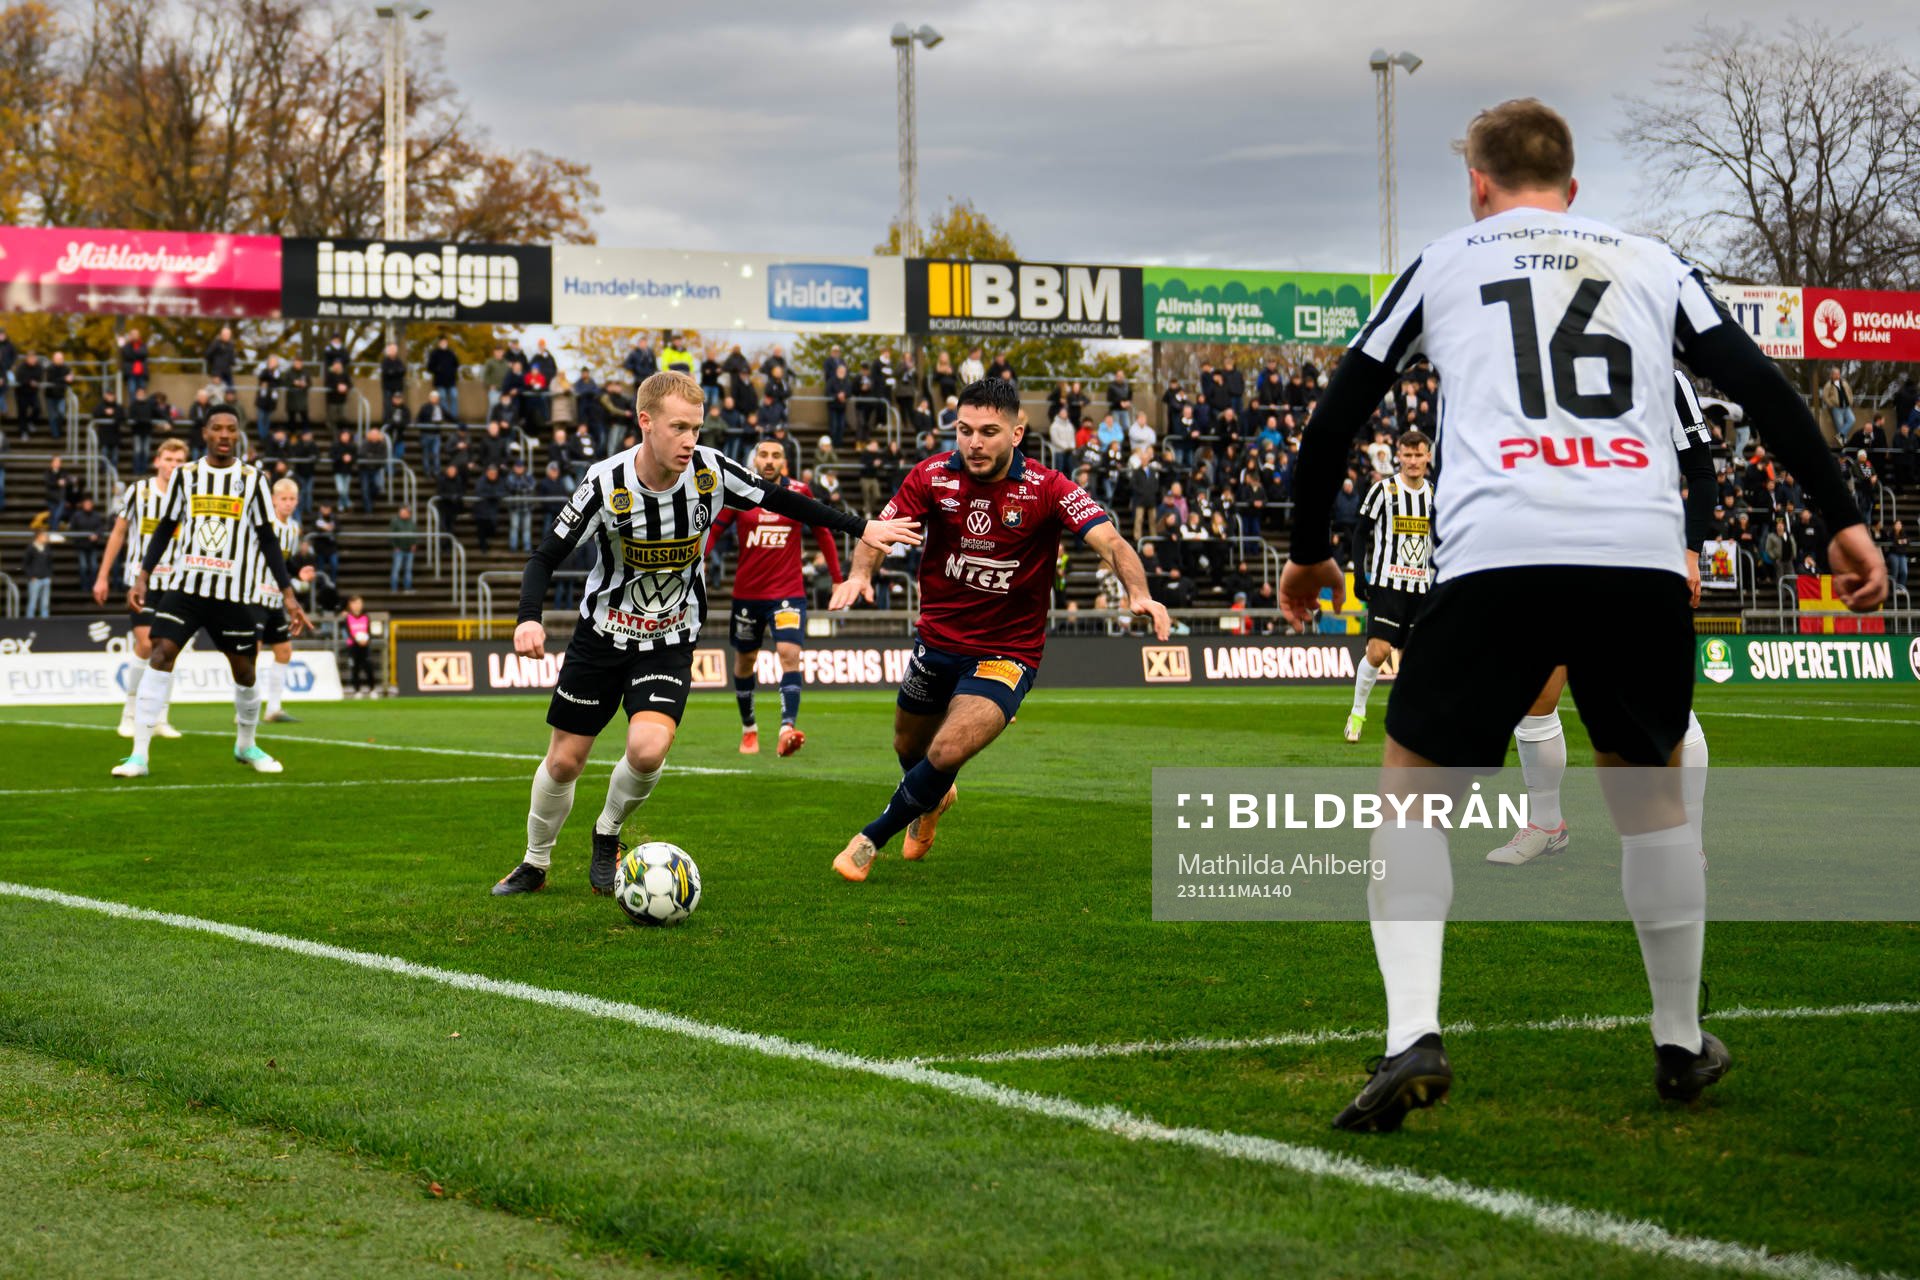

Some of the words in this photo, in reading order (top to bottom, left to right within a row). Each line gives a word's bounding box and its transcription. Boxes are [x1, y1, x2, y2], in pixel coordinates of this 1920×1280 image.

[1467, 228, 1623, 247] Kundpartner
[1513, 254, 1579, 270] STRID
[317, 242, 519, 308] infosign
[563, 277, 720, 300] Handelsbanken
[774, 279, 863, 310] Haldex
[971, 264, 1121, 322] BBM
[1156, 298, 1214, 316] Allmän
[1217, 302, 1263, 320] nytta.
[1322, 306, 1357, 318] LANDS
[929, 319, 1005, 331] BORSTAHUSENS
[1008, 321, 1039, 333] BYGG
[1051, 323, 1103, 335] MONTAGE
[1106, 325, 1120, 335] AB
[1156, 317, 1183, 333] För
[1186, 319, 1223, 335] allas
[1322, 318, 1360, 328] KRONA
[1858, 329, 1891, 343] SKÅNE
[1480, 277, 1634, 419] 16
[1500, 436, 1648, 469] PULS
[746, 525, 792, 548] NTEX
[626, 546, 694, 562] OHLSSONS
[945, 553, 1020, 592] NTEX
[611, 624, 672, 639] LANDSKRONA
[1204, 647, 1355, 680] LANDSKRONA
[1748, 641, 1893, 679] SUPERETTAN
